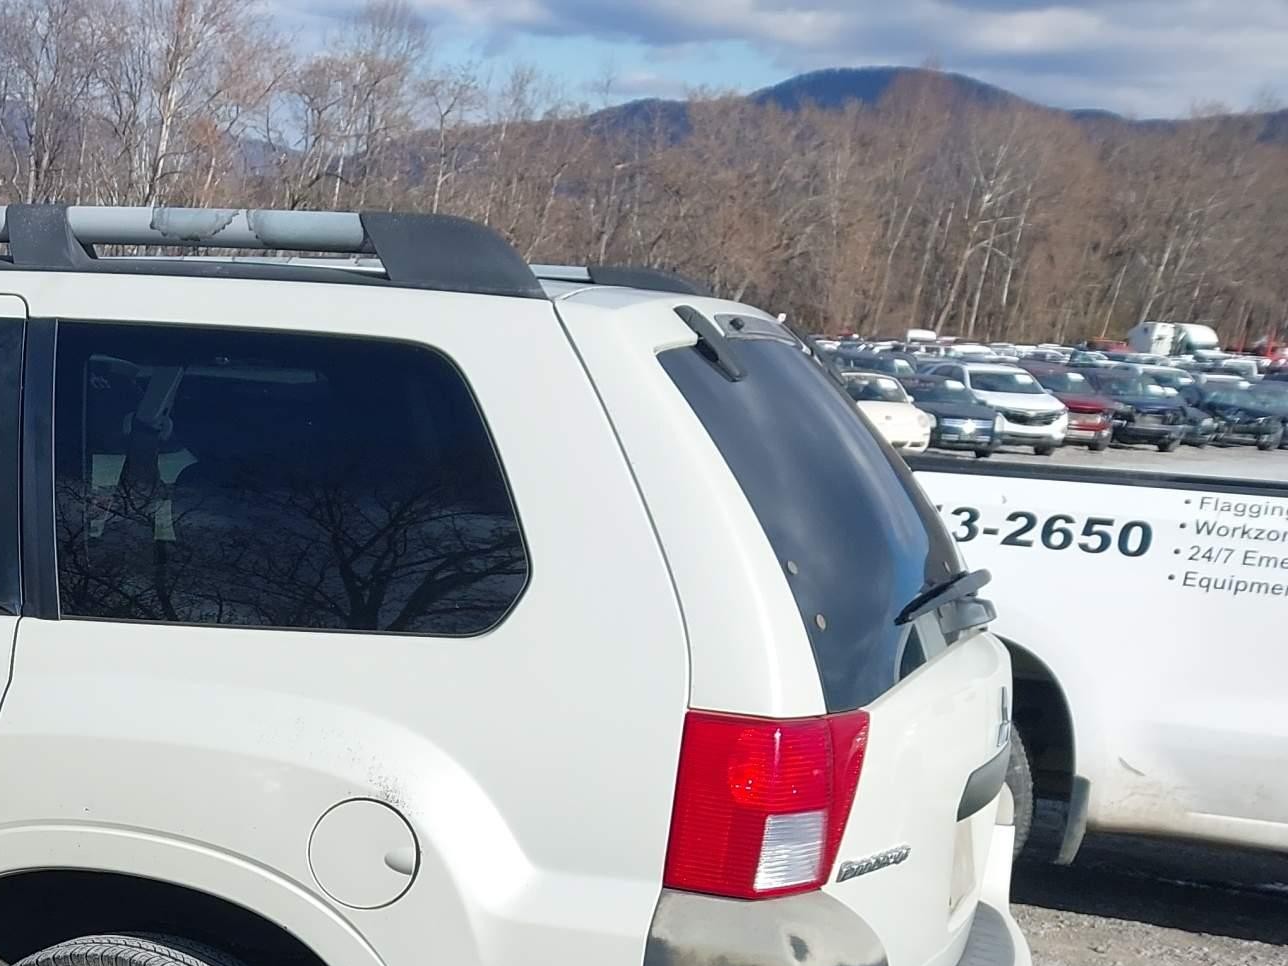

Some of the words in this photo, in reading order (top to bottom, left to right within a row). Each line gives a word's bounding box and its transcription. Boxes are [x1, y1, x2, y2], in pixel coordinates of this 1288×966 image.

[1199, 496, 1288, 520] Flaggin
[936, 505, 1153, 558] 3-2650
[1187, 545, 1235, 564] 24/7
[1182, 571, 1288, 596] Equipme
